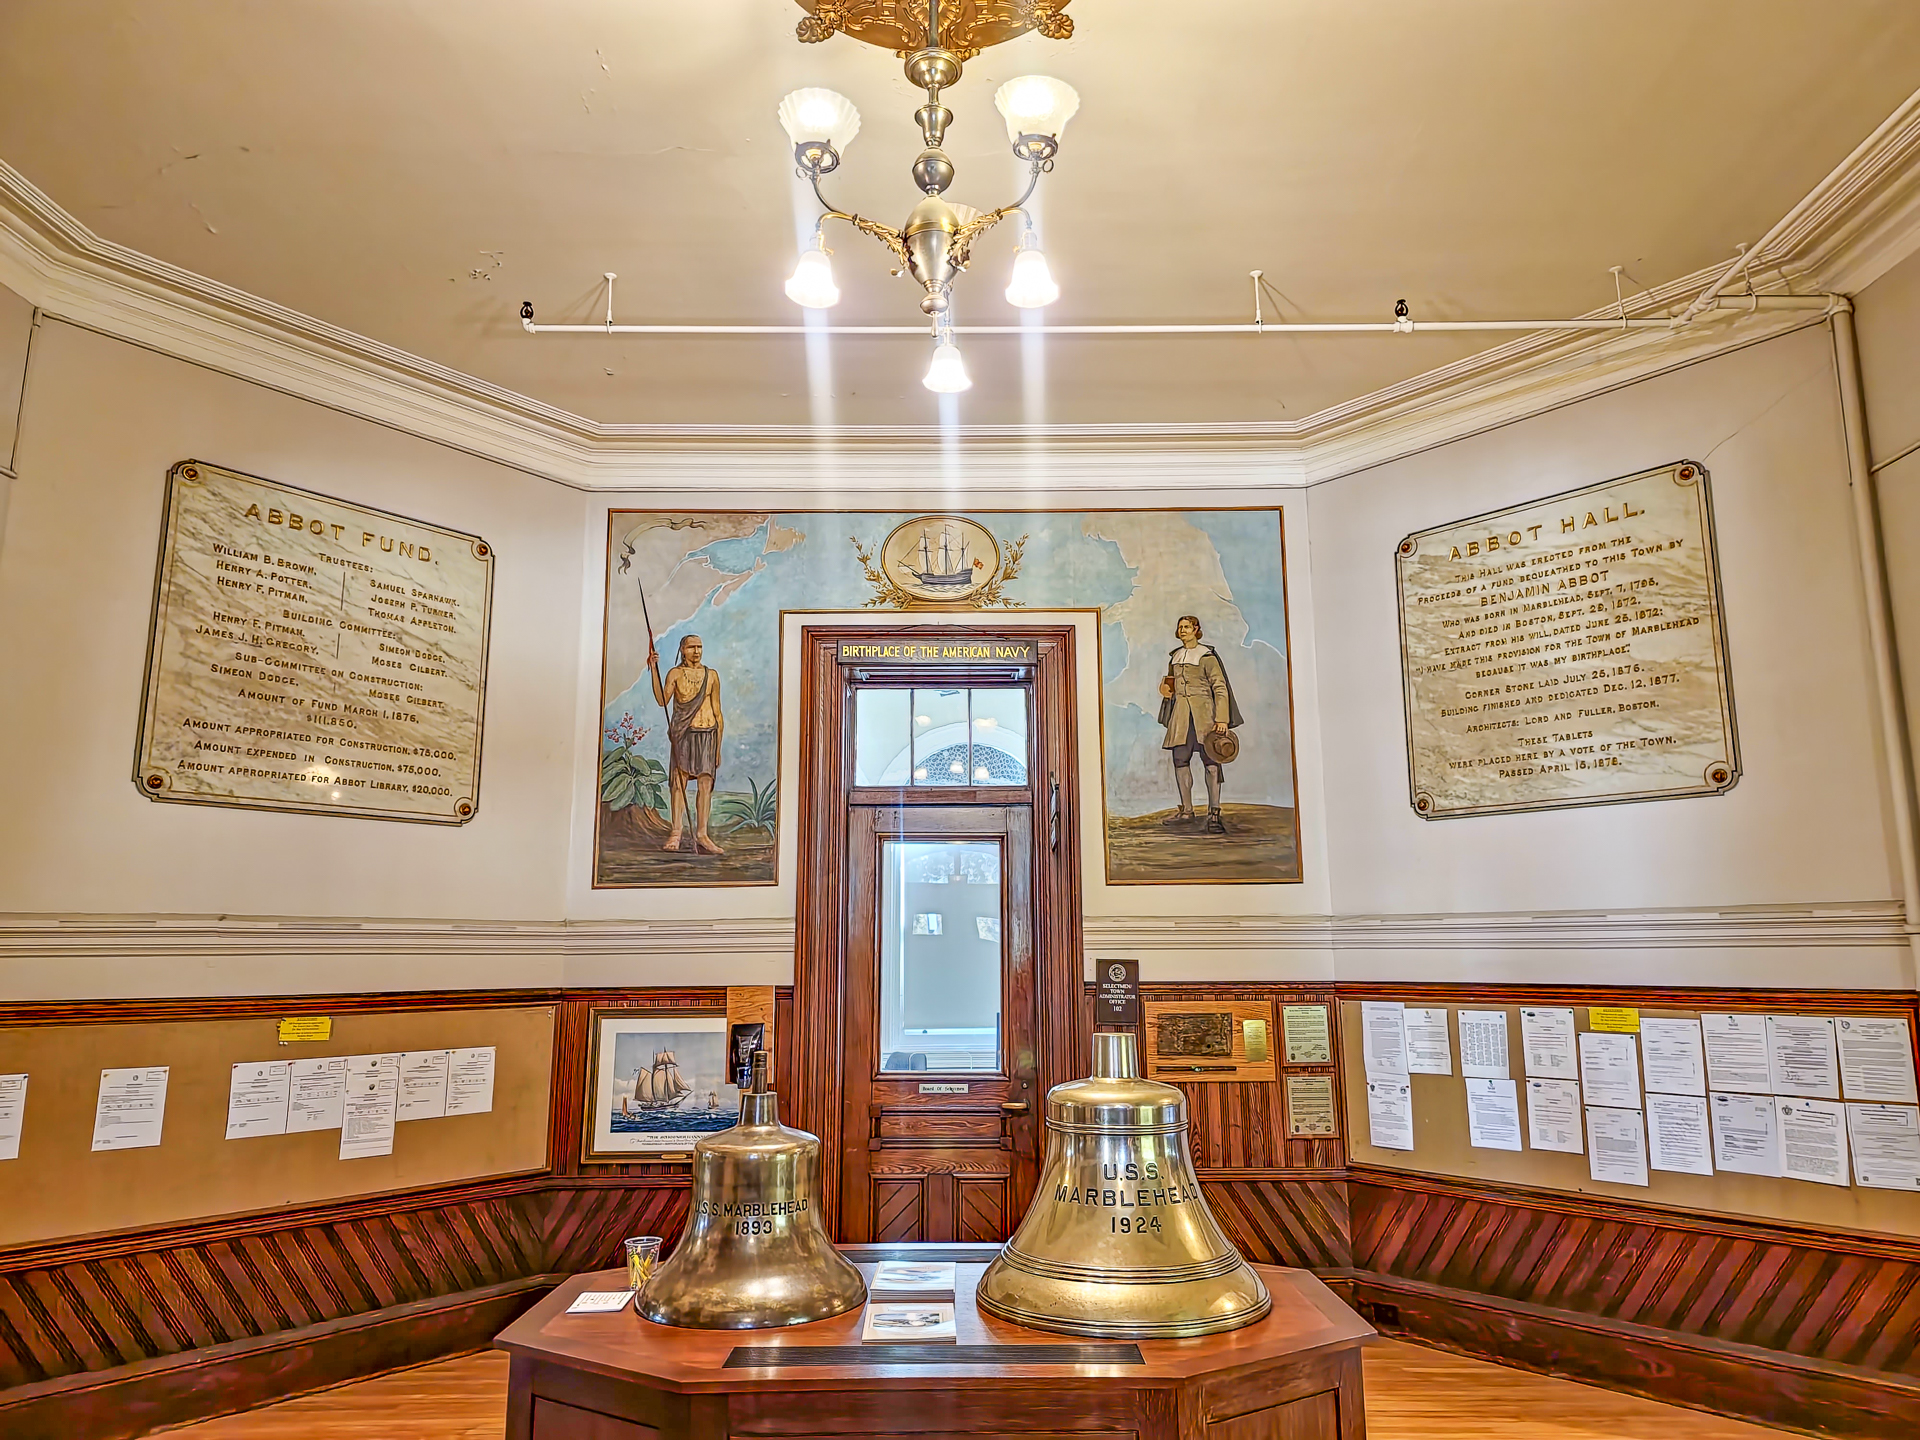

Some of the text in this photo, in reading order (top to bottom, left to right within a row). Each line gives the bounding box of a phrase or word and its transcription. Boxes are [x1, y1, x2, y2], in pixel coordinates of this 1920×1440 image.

[244, 503, 439, 565] ABBOT FUND.
[1448, 502, 1645, 562] ABBOT HALL.
[212, 543, 275, 566] WILLIAM B.
[319, 552, 373, 573] TRUSTEES:
[1455, 536, 1632, 583] THIS HALL WAS ERECTED FROM THE
[216, 560, 251, 575] HENRY
[256, 569, 267, 579] A.
[1417, 590, 1461, 605] PROCEEDS
[1466, 585, 1477, 595] OF
[1490, 577, 1514, 589] FUND
[1520, 563, 1581, 583] BEQUEATHED
[1585, 559, 1598, 568] TO
[1603, 552, 1626, 564] THIS
[1631, 544, 1663, 558] TOWN
[1669, 539, 1684, 549] BY
[217, 576, 252, 591] HENRY
[256, 584, 265, 594] F.
[370, 579, 406, 595] SAMUEL
[1480, 570, 1609, 607] BENJAMIN ABBOT
[370, 594, 406, 609] JOSEPH
[410, 602, 418, 612] P.
[1442, 588, 1613, 629] WHO WAS BORN IN SEPT.
[213, 611, 248, 626] HENRY
[252, 619, 261, 629] F.
[282, 609, 396, 640] BUILDING COMMITTEE:
[368, 607, 405, 623] THOMAS
[1458, 630, 1476, 640] AND
[1479, 625, 1498, 636] DIED
[1502, 622, 1511, 631] IN
[1558, 609, 1585, 620] SEPT.
[195, 625, 234, 640] JAMES
[238, 632, 248, 642] J.
[251, 634, 263, 645] H.
[1426, 617, 1700, 674] HAVE MADE THIS PROVISION FOR THE TOWN OF MARBLEHEAD
[1444, 643, 1481, 656] EXTRACT
[1485, 637, 1508, 648] FROM
[1510, 635, 1525, 644] HIS
[1552, 624, 1581, 636] DATED
[1586, 619, 1610, 630] JUNE
[379, 643, 411, 656] SIMEON
[842, 645, 1030, 658] BIRTHPLACE OF THE AMERICAN NAVY
[235, 652, 423, 691] SUB-COMMITTEE ON CONSTRUCTION:
[371, 656, 402, 669] MOSES
[1475, 655, 1567, 679] BECAUSE IT WAS MY
[210, 663, 299, 687] SIMEON DODGE.
[1465, 687, 1500, 700] CORNER
[1505, 682, 1535, 693] STONE
[1538, 678, 1559, 688] LAID
[1563, 673, 1587, 684] JULY
[238, 688, 419, 724] AMOUNT OF FUND MARCH 1876.
[368, 689, 400, 701] MOSES
[1441, 705, 1479, 718] BUILDING
[1482, 699, 1521, 712] FINISHED
[1524, 695, 1544, 706] AND
[1548, 687, 1599, 702] DEDICATED
[1603, 683, 1627, 693] DEC.
[183, 718, 334, 745] AMOUNT APPROPRIATED FOR
[1466, 720, 1520, 733] ARCHITECTS:
[1525, 715, 1549, 725] LORD
[1553, 712, 1572, 721] AND
[1517, 730, 1594, 747] THESE TABLETS
[194, 740, 241, 754] AMOUNT
[246, 748, 297, 760] EXPENDED
[304, 754, 315, 763] IN
[1449, 760, 1473, 769] WERE
[1477, 755, 1512, 766] PLACED
[1515, 752, 1538, 762] HERE
[1543, 750, 1555, 759] BY
[1559, 748, 1566, 757] A
[1570, 745, 1595, 756] VOTE
[1600, 743, 1613, 752] OF
[1616, 740, 1636, 750] THE
[177, 760, 224, 773] AMOUNT
[228, 767, 306, 782] APPROPRIATED
[311, 776, 329, 784] FOR
[334, 776, 366, 788] ABBOT
[1499, 767, 1534, 779] PASSED
[1539, 763, 1570, 774] APRIL
[1103, 1162, 1164, 1181] U.S.S.
[1054, 1183, 1198, 1207] MARBLEHEAD
[723, 1199, 808, 1217] MARBLEHEAD
[735, 1220, 773, 1236] 1893
[1111, 1216, 1162, 1234] 1924
